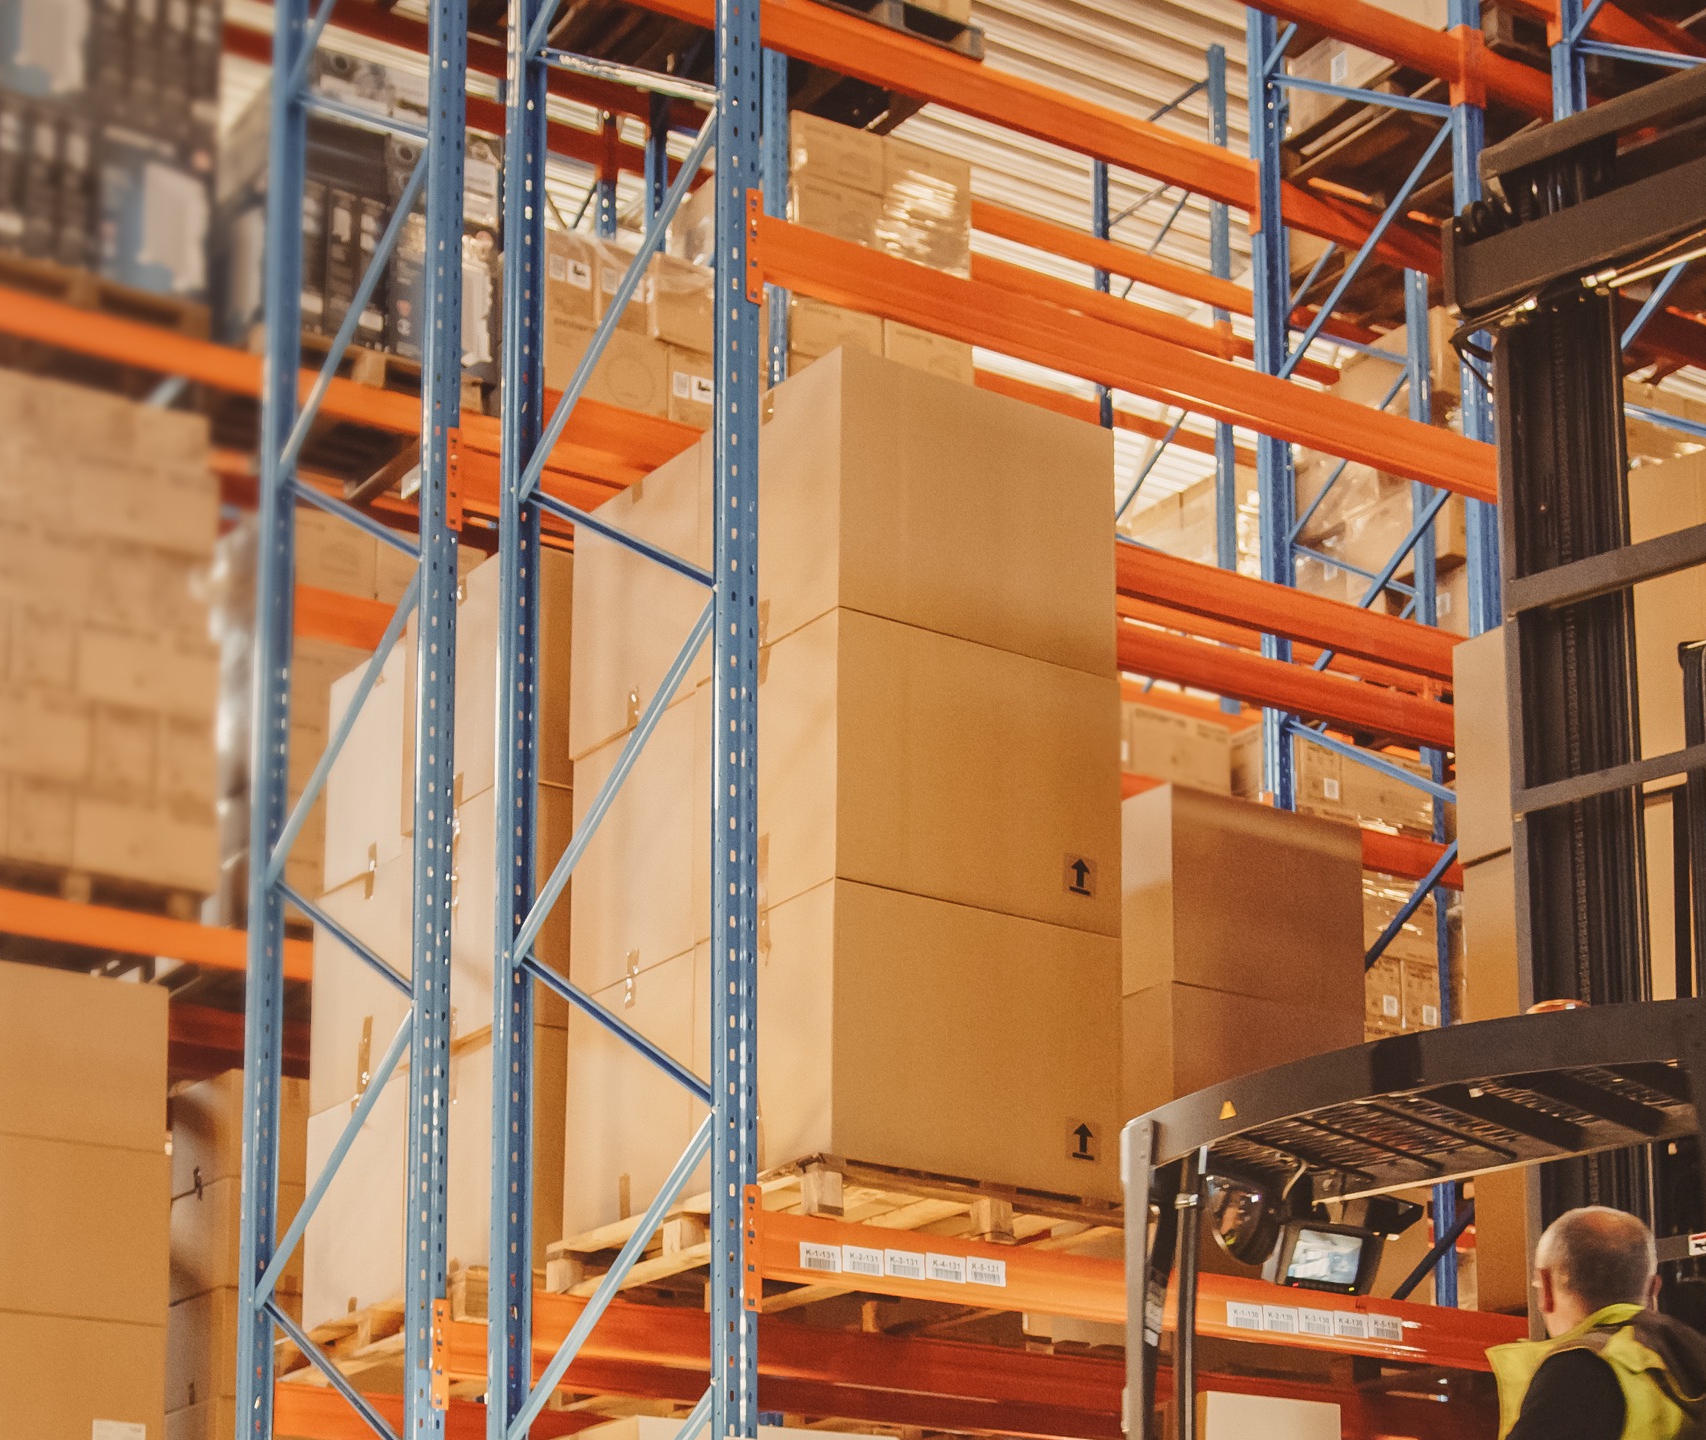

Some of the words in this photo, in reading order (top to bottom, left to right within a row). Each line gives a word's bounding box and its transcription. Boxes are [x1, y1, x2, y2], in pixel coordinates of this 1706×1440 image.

[805, 1249, 835, 1259] K-1-131
[849, 1252, 879, 1263] K-2-131
[890, 1256, 919, 1266] K-3-131
[932, 1259, 961, 1270] K-4-131
[971, 1262, 1000, 1273] K-5-131
